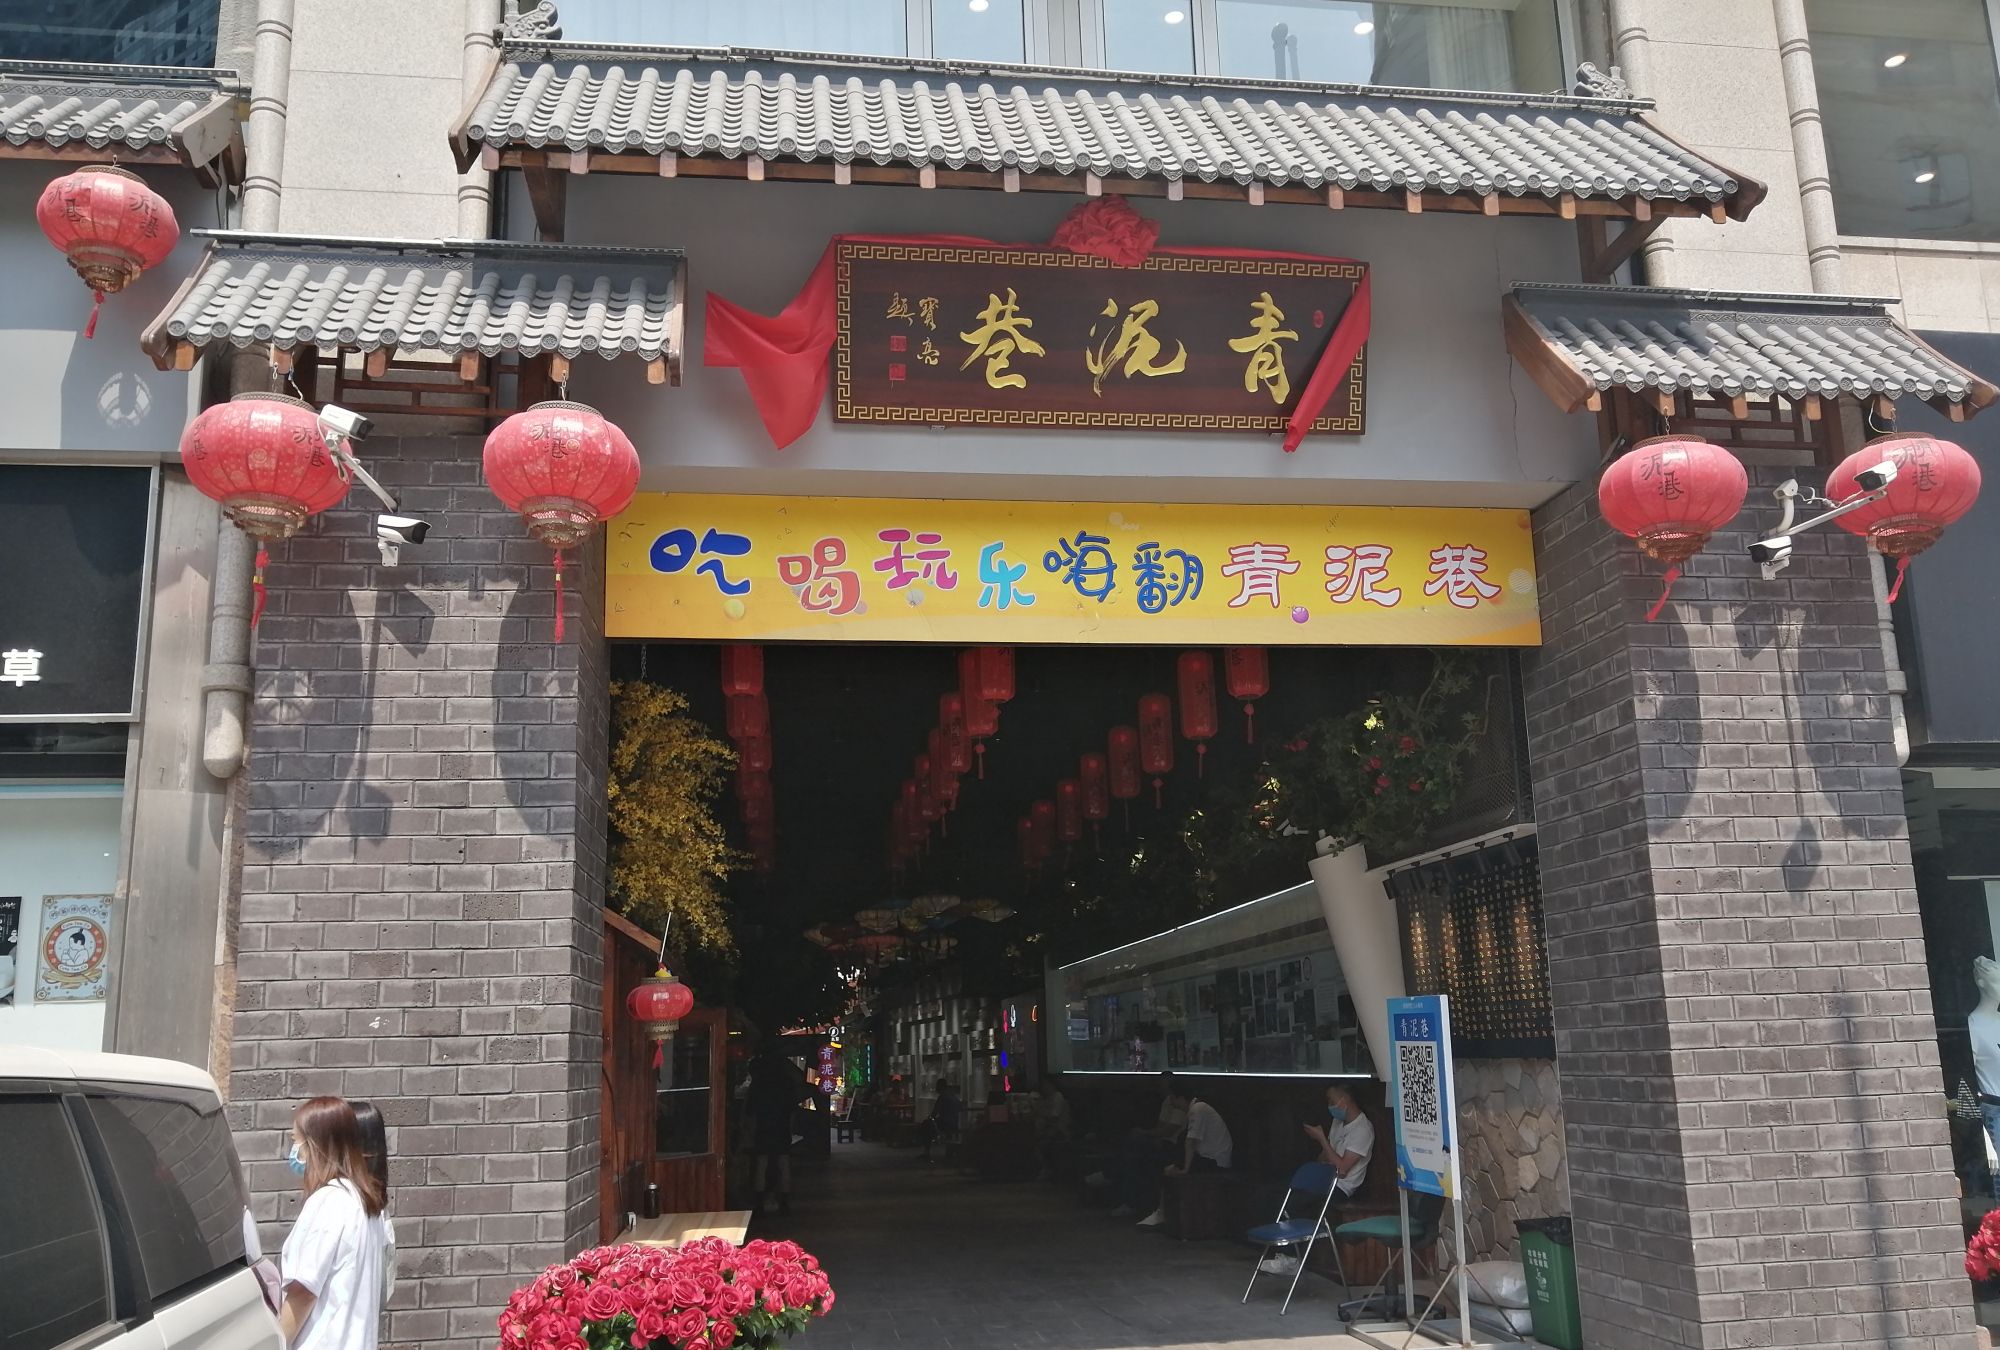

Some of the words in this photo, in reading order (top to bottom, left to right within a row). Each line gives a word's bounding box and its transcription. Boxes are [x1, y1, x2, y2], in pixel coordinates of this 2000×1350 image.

[649, 528, 1501, 616] 吃喝玩乐嗨翻青泥巷
[0, 648, 44, 687] 草
[1400, 1018, 1429, 1038] 青泥巷
[820, 1047, 834, 1092] 青泥巷
